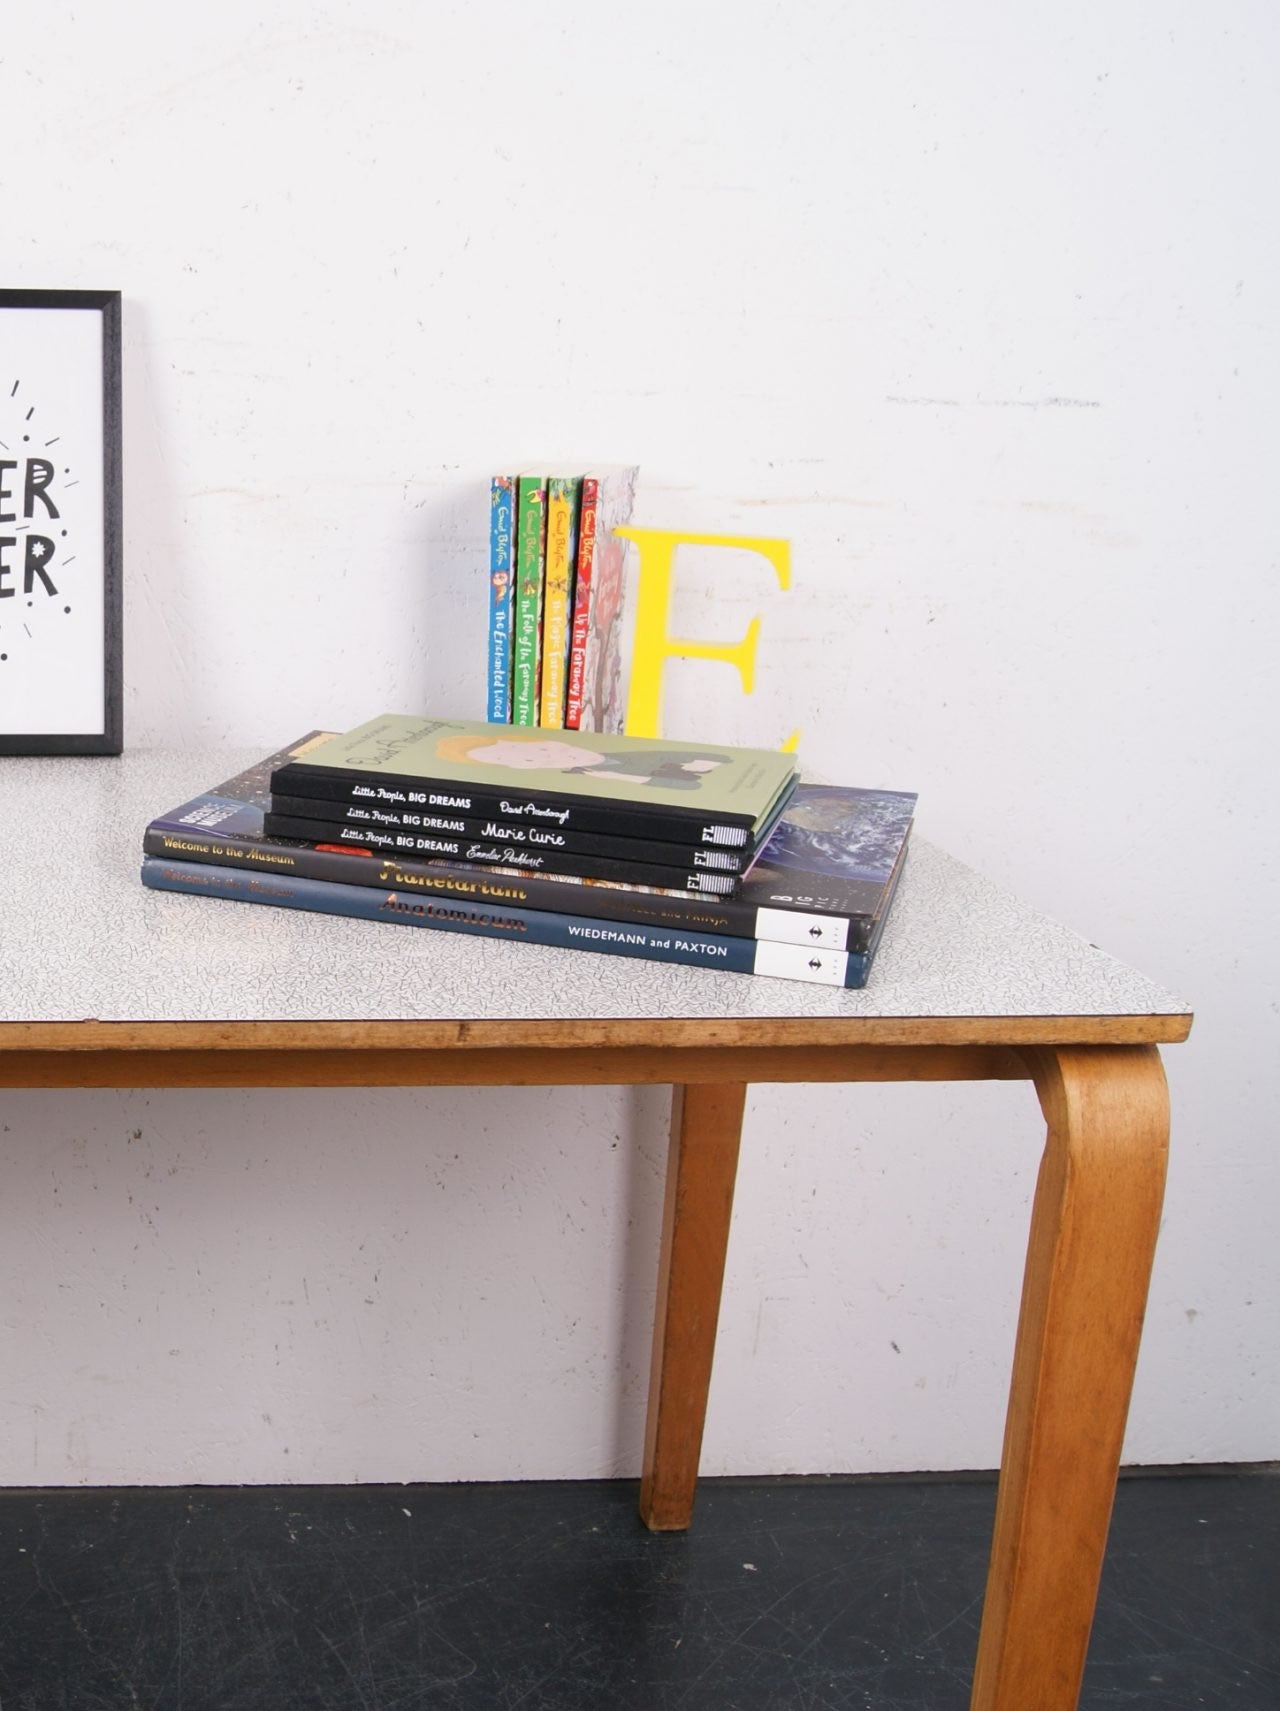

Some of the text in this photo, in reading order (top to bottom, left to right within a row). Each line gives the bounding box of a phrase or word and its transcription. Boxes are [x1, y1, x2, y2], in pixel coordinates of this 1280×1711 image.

[494, 506, 509, 566] Enid Blyton
[580, 510, 595, 569] Enid Blyton
[522, 614, 534, 634] Folk
[575, 613, 588, 625] Up
[519, 636, 532, 647] of
[494, 610, 506, 718] The Enchanted Wood
[547, 651, 560, 698] Faraway
[570, 647, 586, 697] Faraway
[519, 663, 531, 701] Faraway
[520, 704, 529, 726] Tree
[548, 702, 557, 723] Tree
[569, 699, 581, 721] Tree
[352, 785, 471, 809] Little People, BIG DREAMS
[346, 807, 465, 831] Little People, BIG DREAMS
[340, 828, 459, 853] Little People, BIG DREAMS
[481, 823, 566, 846] Marie Curie
[162, 836, 295, 865] Welcome to the Museum
[379, 861, 527, 900] Planetarium
[378, 893, 528, 932] Anatomicum
[568, 926, 728, 957] WIEDEMANN and PAXTON
